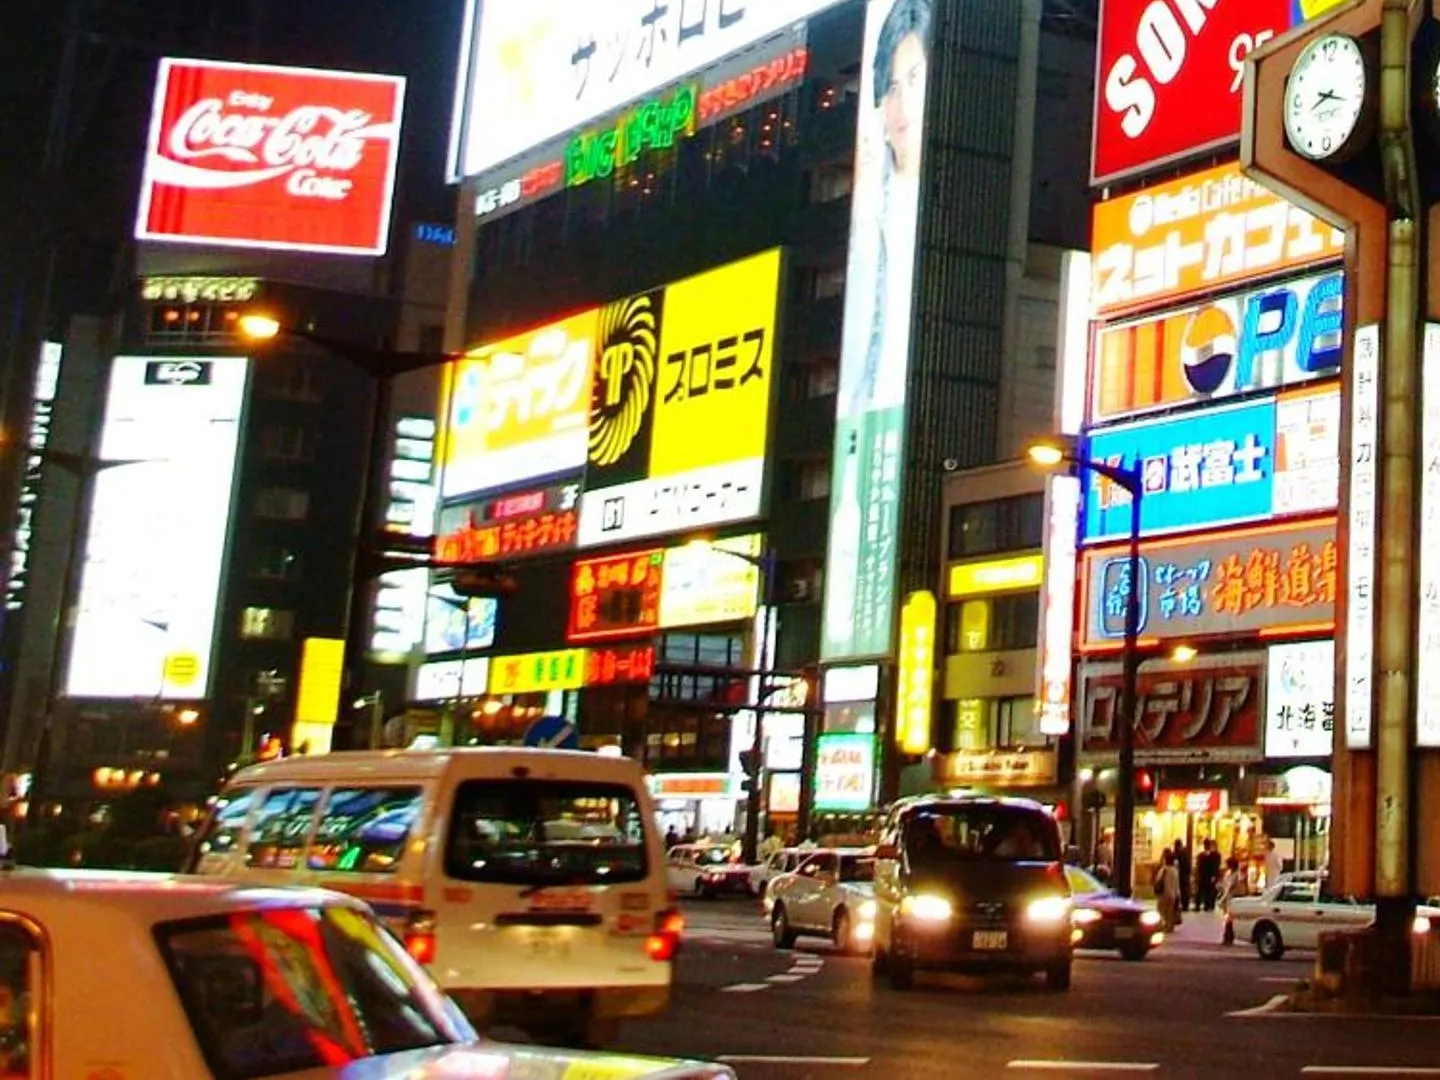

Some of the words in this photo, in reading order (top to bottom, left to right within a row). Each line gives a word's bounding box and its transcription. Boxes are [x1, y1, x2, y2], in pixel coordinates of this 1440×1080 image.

[1322, 40, 1338, 62] 12
[229, 89, 273, 108] Enjoy
[171, 97, 371, 170] Coca-Cola
[287, 170, 352, 199] Coke
[1086, 675, 1250, 741] ロテリア
